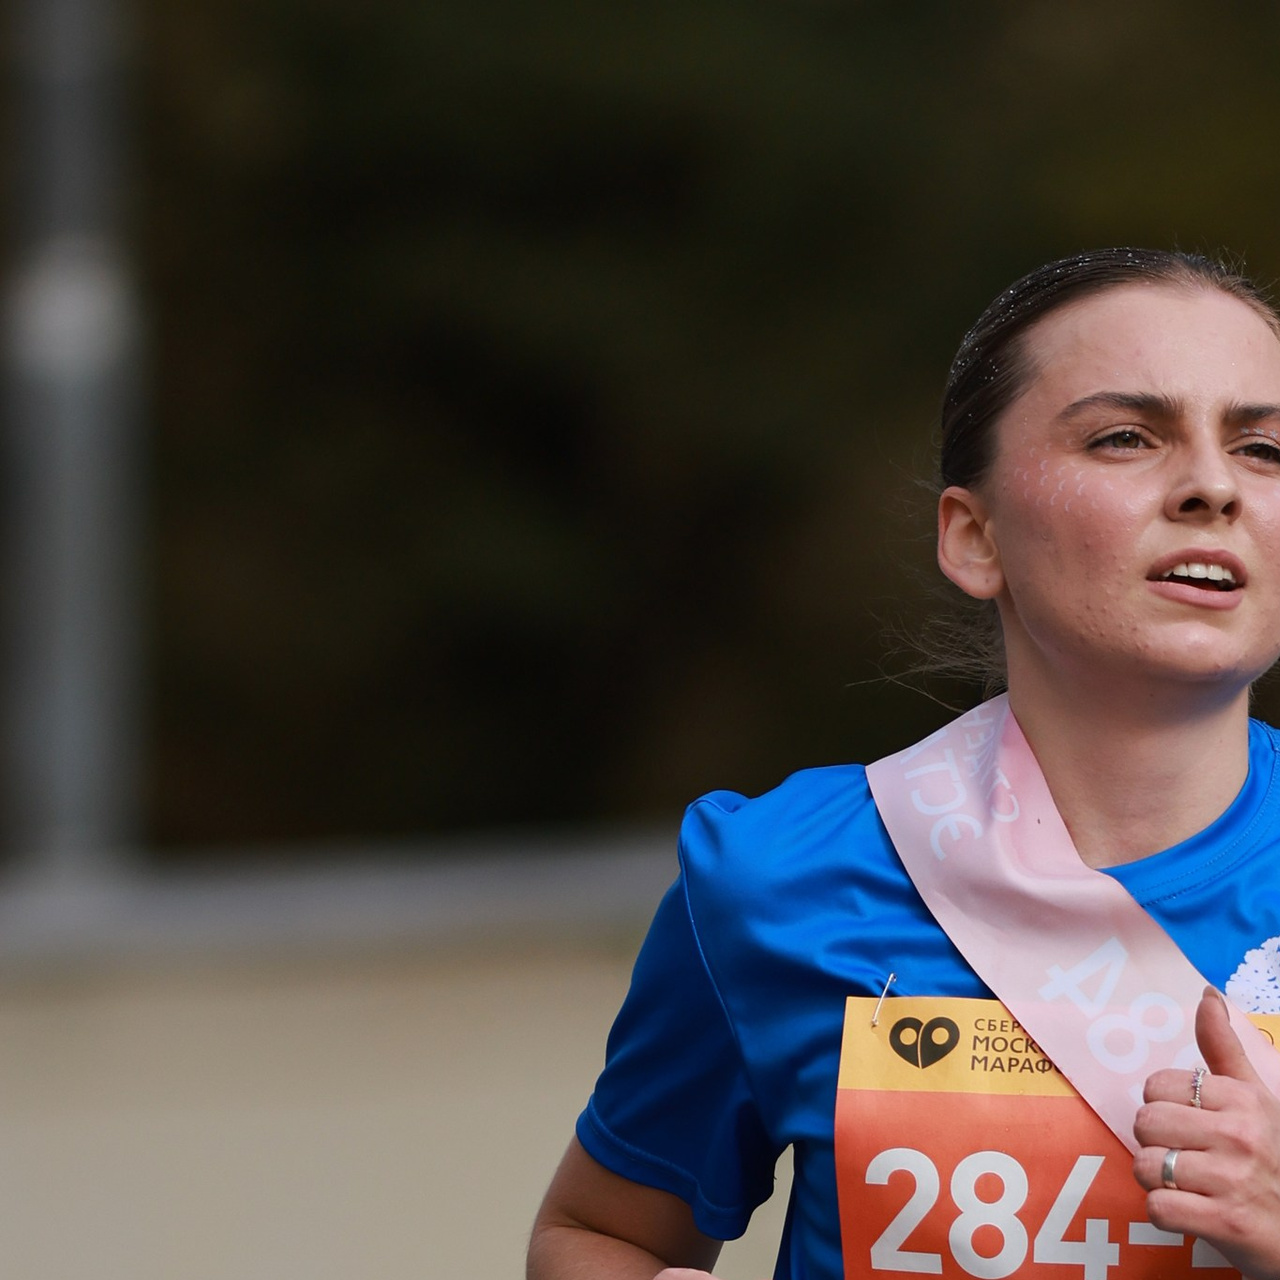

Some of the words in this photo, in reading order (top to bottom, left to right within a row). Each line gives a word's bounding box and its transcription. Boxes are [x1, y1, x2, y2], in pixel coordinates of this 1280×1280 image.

[974, 1018, 1027, 1033] СБЕР
[972, 1035, 1046, 1054] МОСК
[970, 1055, 1063, 1075] МАРАФ
